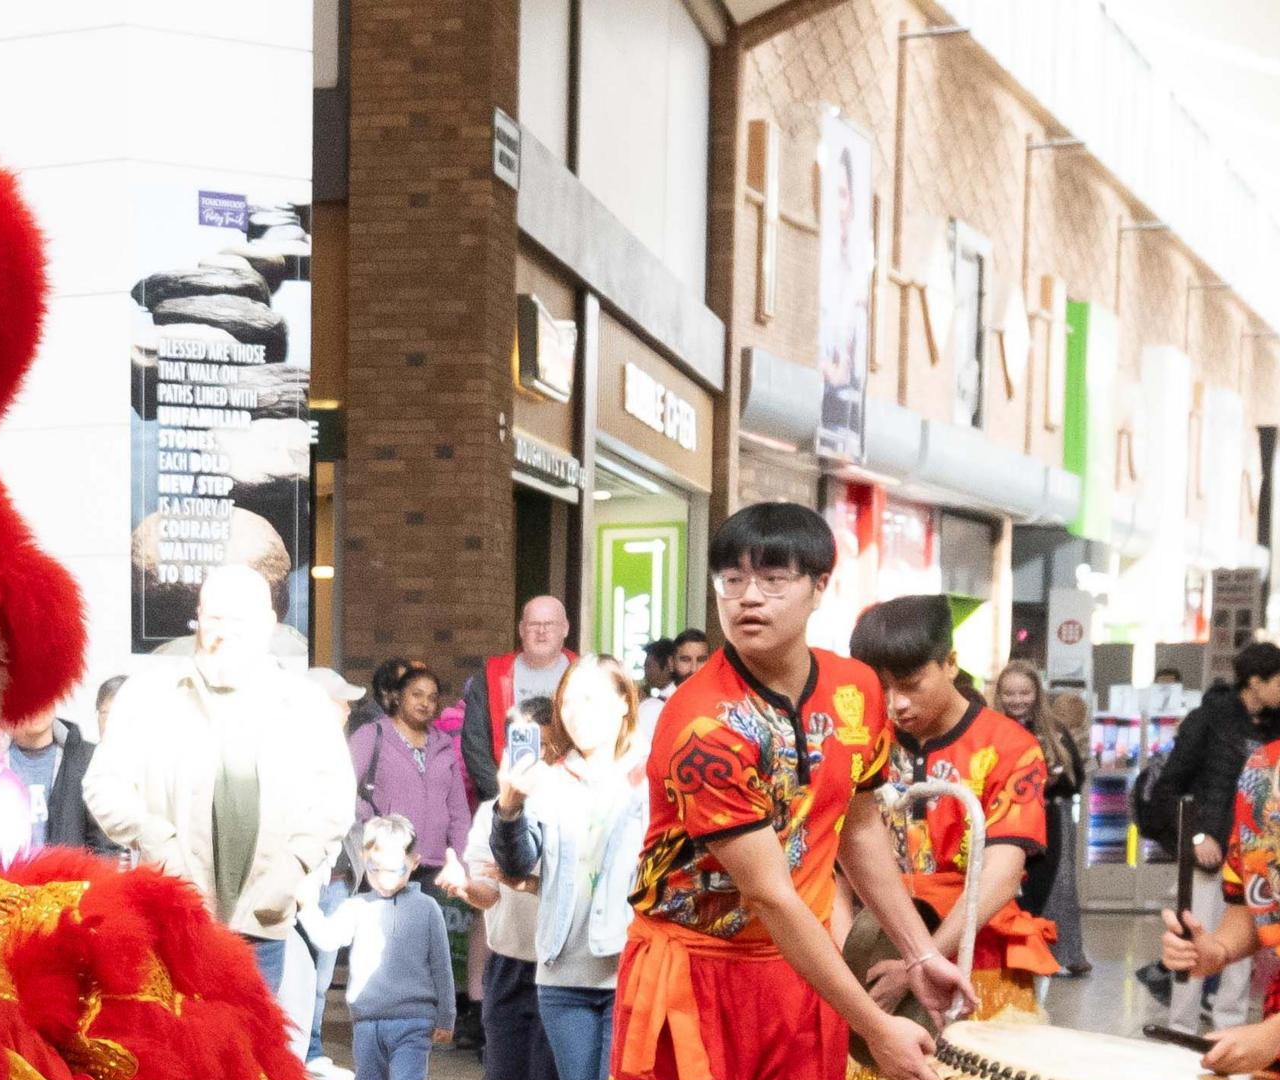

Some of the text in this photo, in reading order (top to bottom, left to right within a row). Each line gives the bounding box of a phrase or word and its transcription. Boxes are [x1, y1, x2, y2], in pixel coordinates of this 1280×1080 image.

[159, 338, 266, 363] BLESSED ARE THOSE
[159, 360, 239, 384] THAT WALK ON
[158, 383, 258, 408] PATHS LINED WITH
[158, 406, 251, 428] UNFAMILIAR
[159, 451, 230, 474] EACH BOLD
[158, 473, 234, 496] NEW STEP
[159, 496, 235, 518] IS A STORY OF
[159, 519, 230, 541] COURAGE
[159, 541, 225, 562] WAITING
[158, 564, 179, 584] TO
[180, 564, 202, 585] BE
